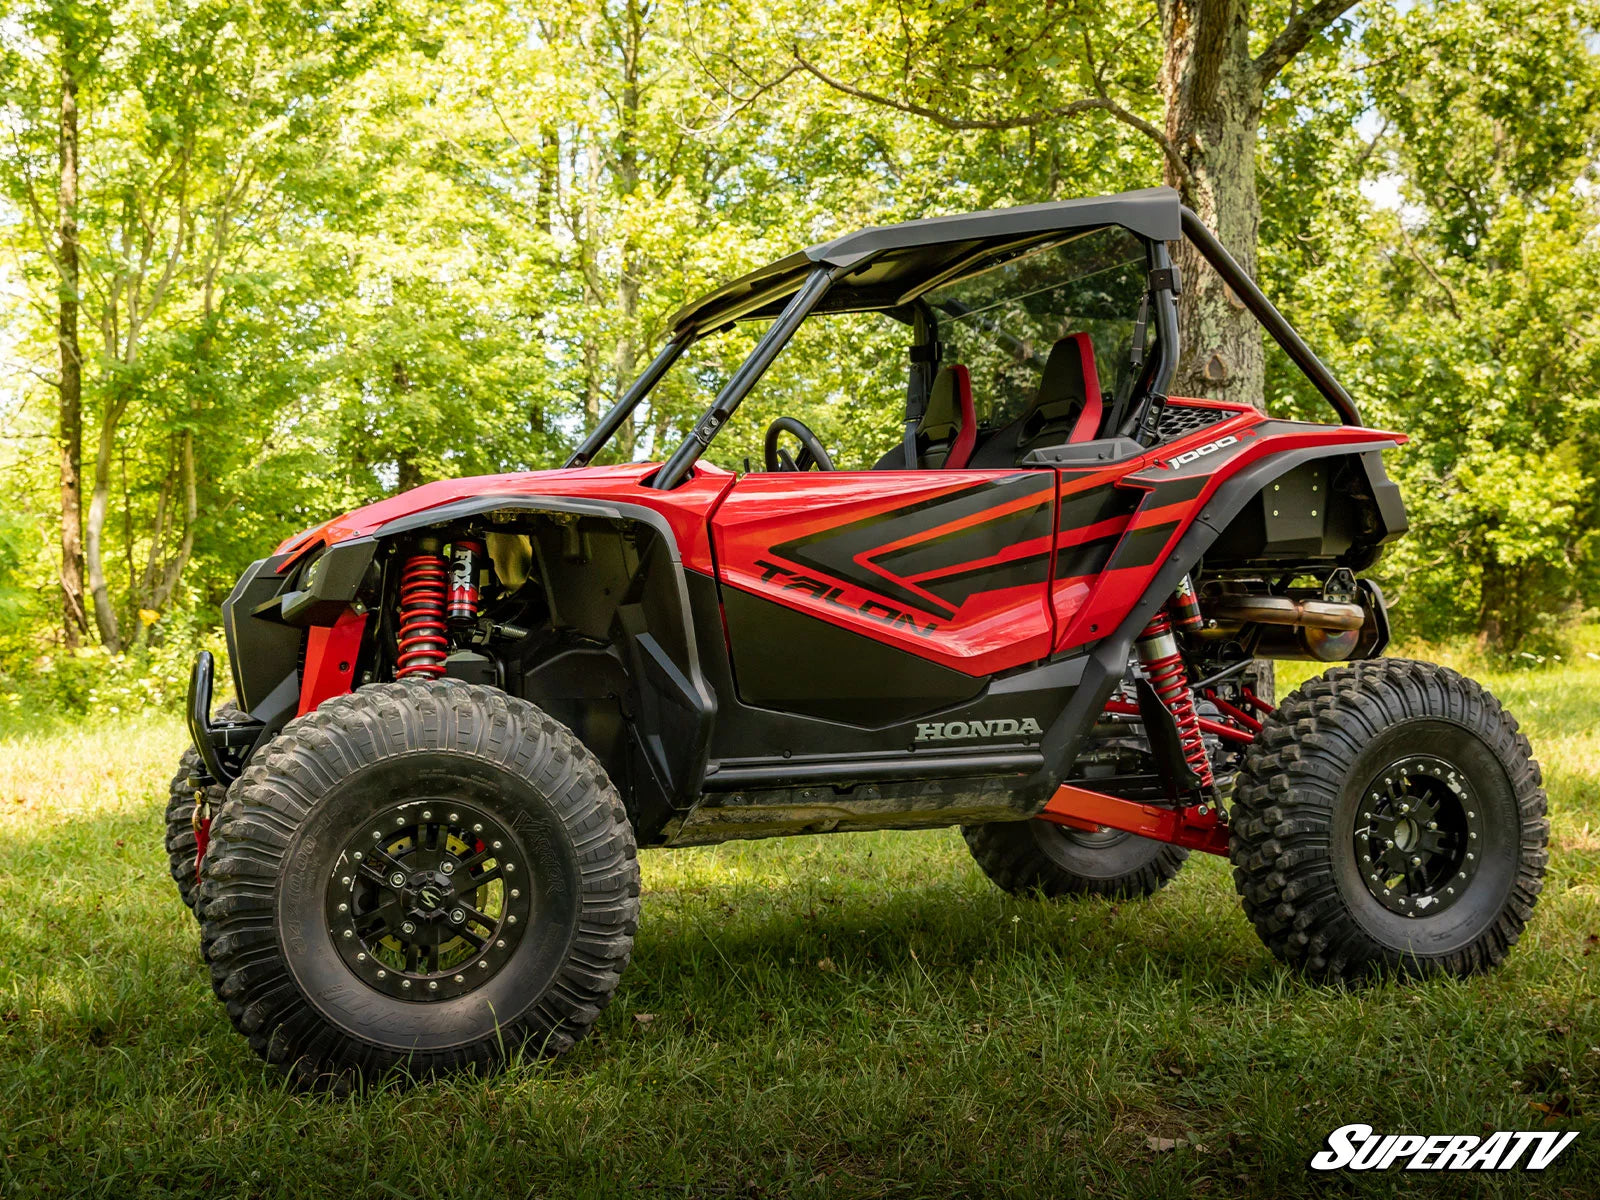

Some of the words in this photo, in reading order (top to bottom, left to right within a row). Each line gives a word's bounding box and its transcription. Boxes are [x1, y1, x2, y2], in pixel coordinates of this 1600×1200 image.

[451, 549, 473, 592] FOX
[754, 559, 940, 638] TALON
[914, 717, 1043, 742] HONDA
